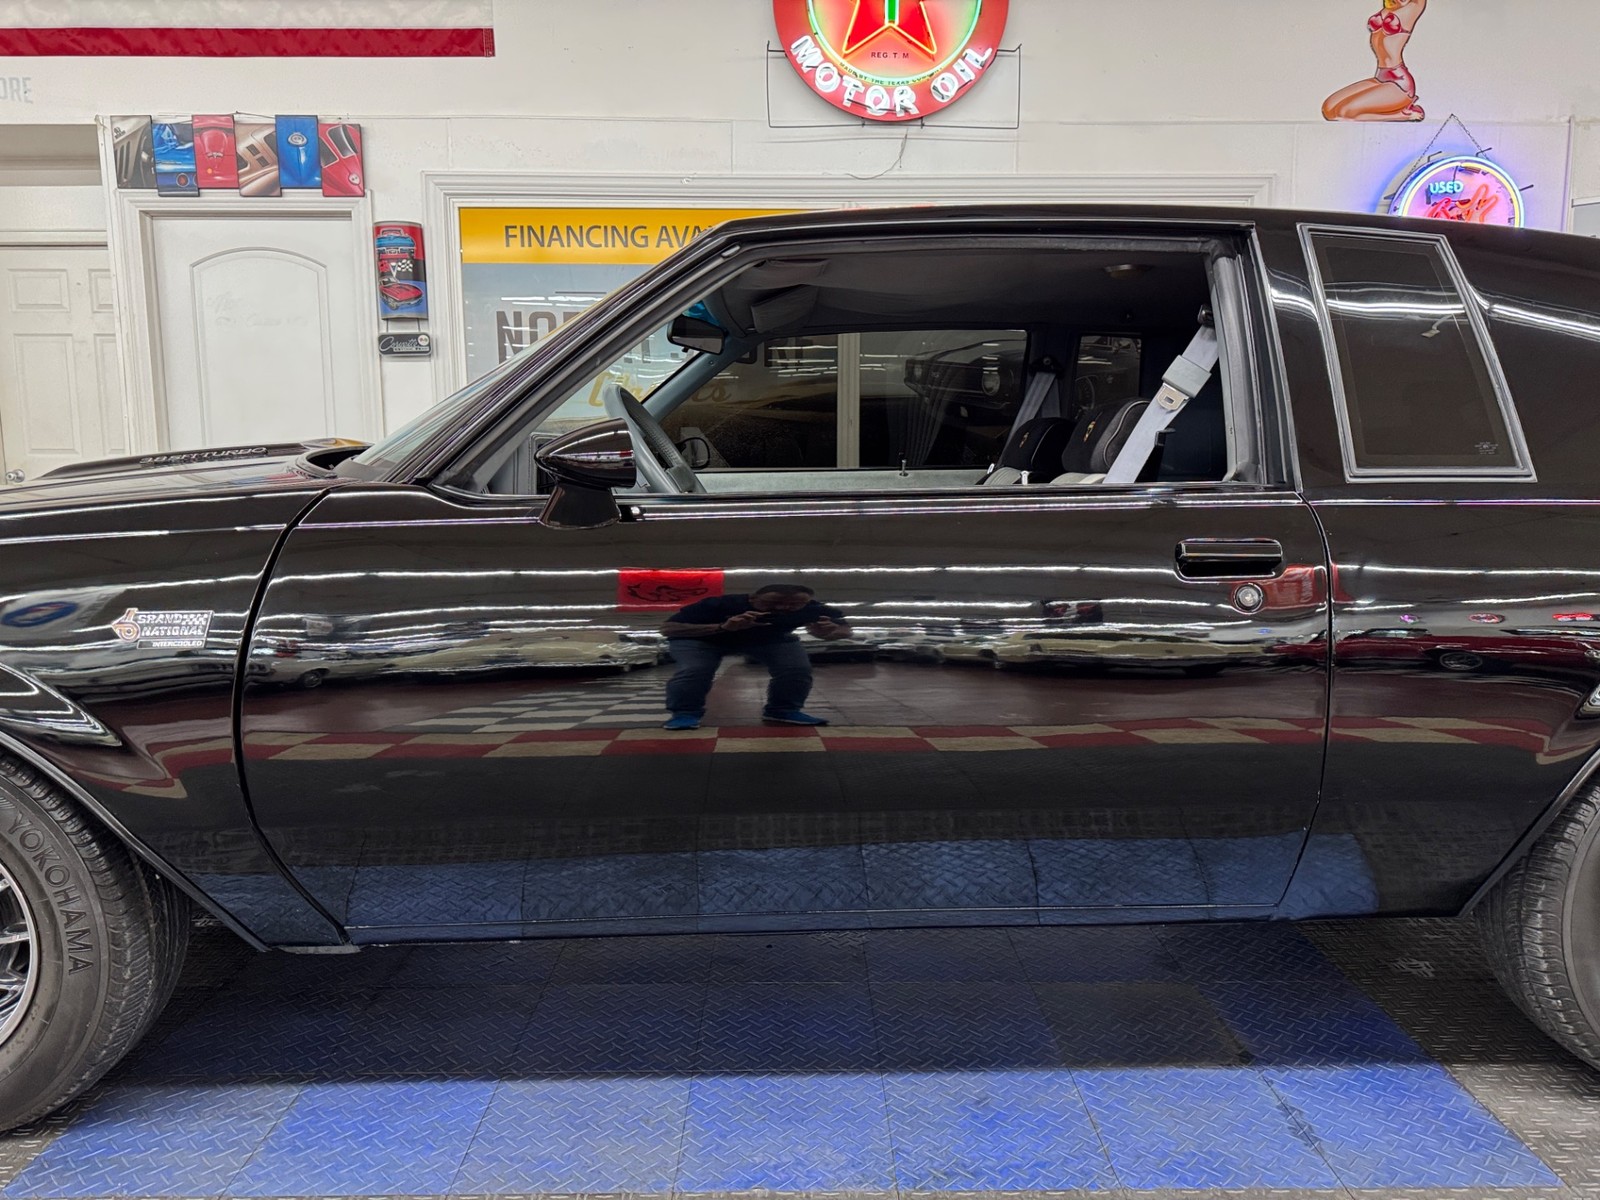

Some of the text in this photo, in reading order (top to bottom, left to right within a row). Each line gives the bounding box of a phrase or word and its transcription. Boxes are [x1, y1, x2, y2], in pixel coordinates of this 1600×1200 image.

[790, 35, 993, 117] MOTOR OIL
[1429, 180, 1464, 194] USED
[504, 224, 649, 249] FINANCING
[137, 613, 182, 624] GRAND
[141, 625, 204, 636] NATIONAL
[152, 640, 203, 648] INTERCOOLED
[7, 811, 94, 976] YOKOHAMA
